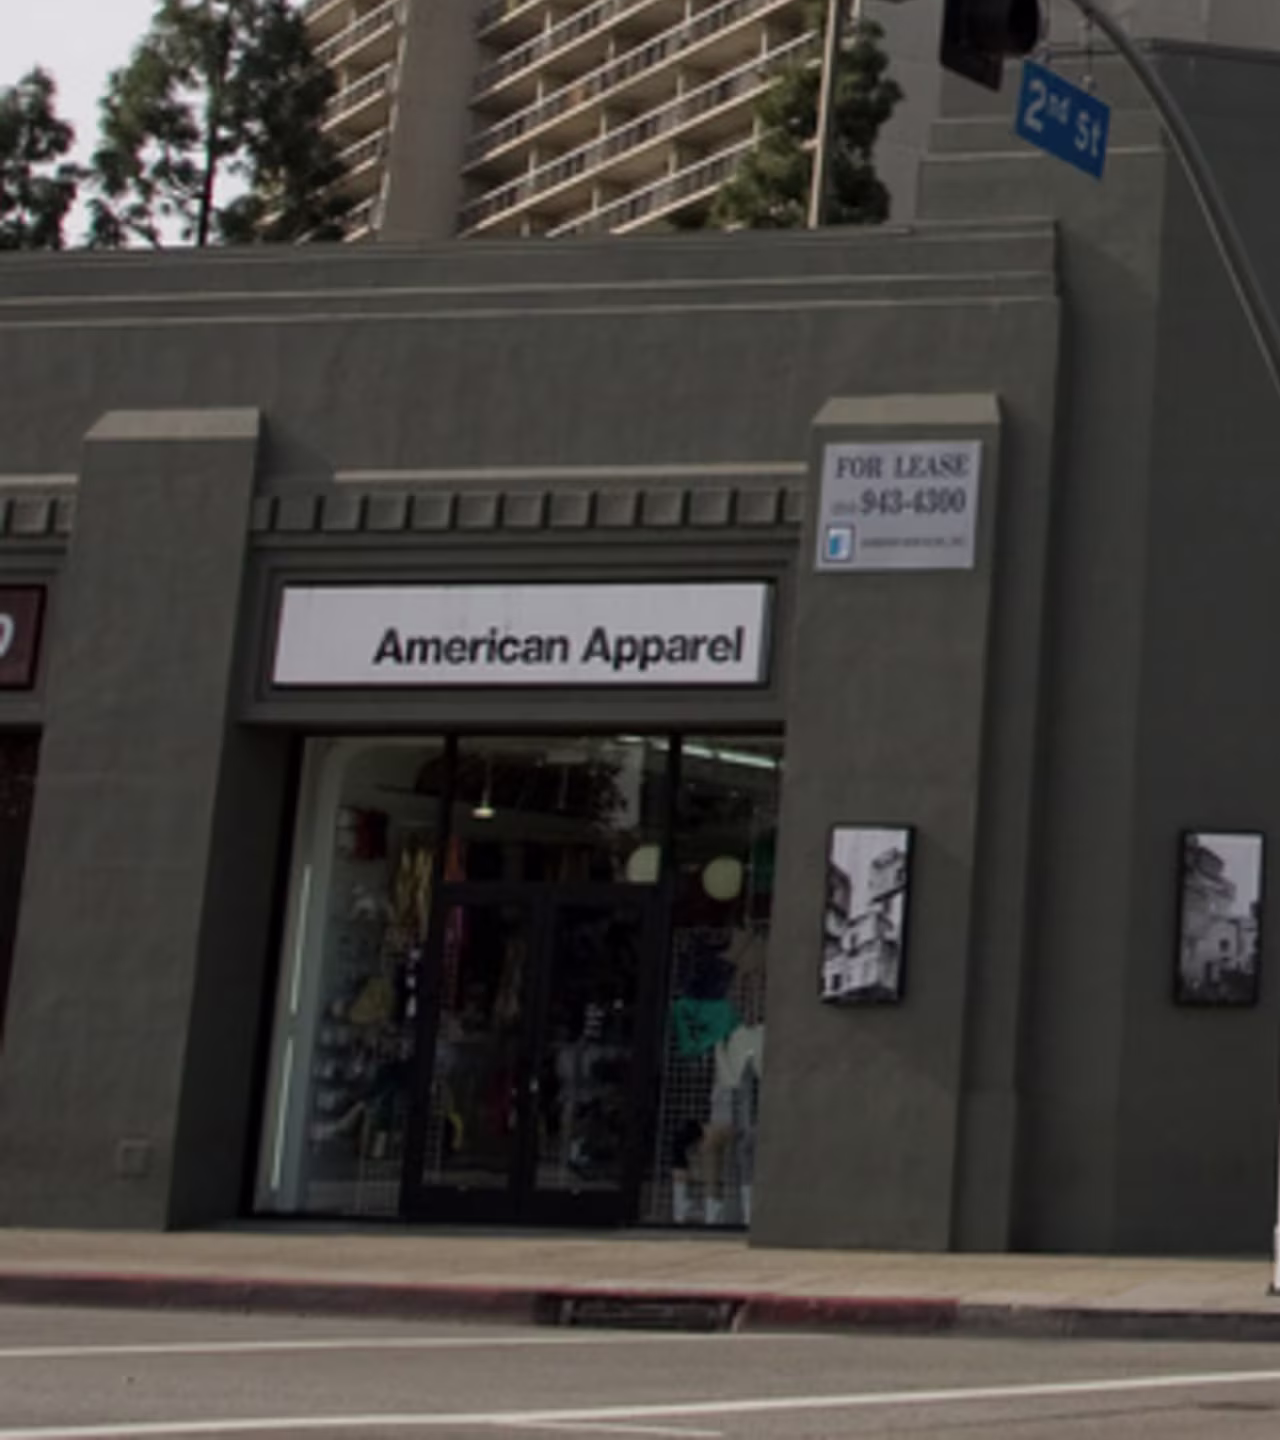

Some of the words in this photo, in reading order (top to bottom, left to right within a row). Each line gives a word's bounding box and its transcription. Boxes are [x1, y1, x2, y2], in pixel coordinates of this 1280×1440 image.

[835, 455, 882, 479] FOR
[894, 453, 969, 479] LEASE
[373, 624, 568, 666] American
[581, 624, 745, 673] Apparel
